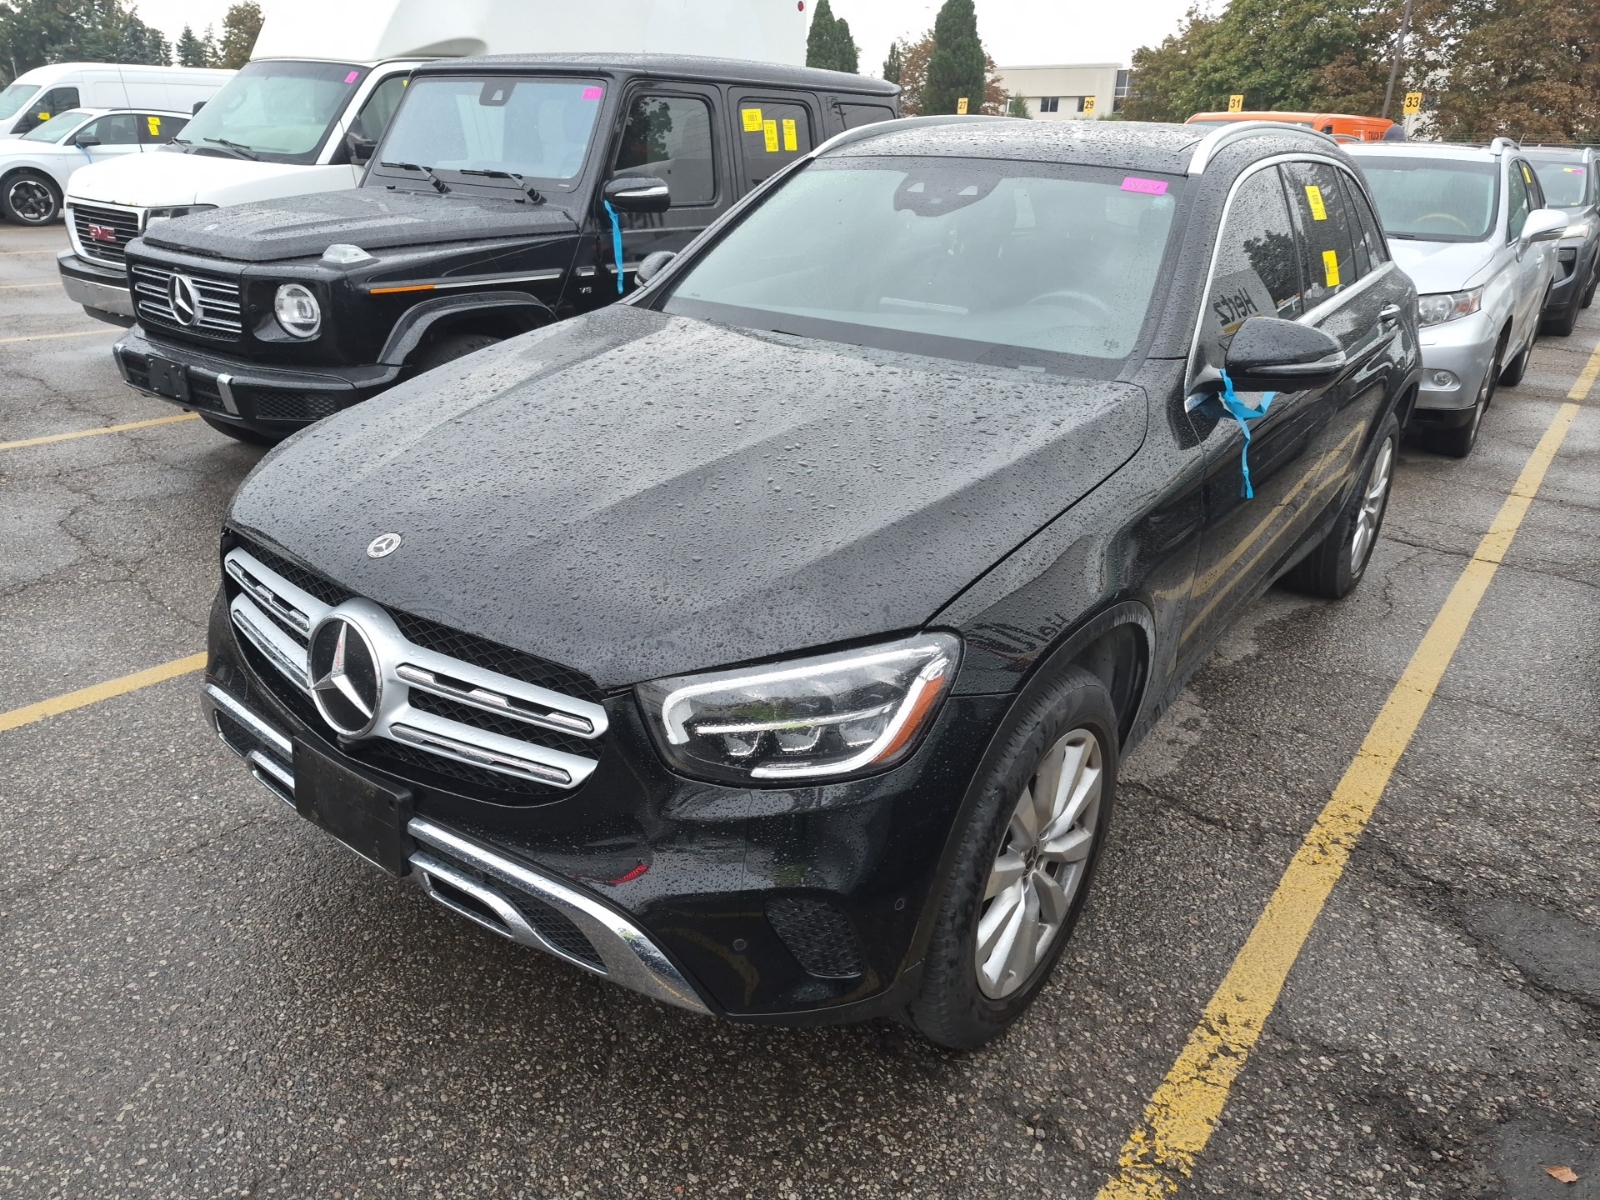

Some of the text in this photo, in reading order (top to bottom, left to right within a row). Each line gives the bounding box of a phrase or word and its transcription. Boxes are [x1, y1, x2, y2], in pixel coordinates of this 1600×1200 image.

[958, 101, 967, 110] 27
[1085, 100, 1094, 109] 29
[1230, 98, 1241, 109] 31
[1406, 96, 1420, 108] 33
[88, 224, 117, 242] GMC
